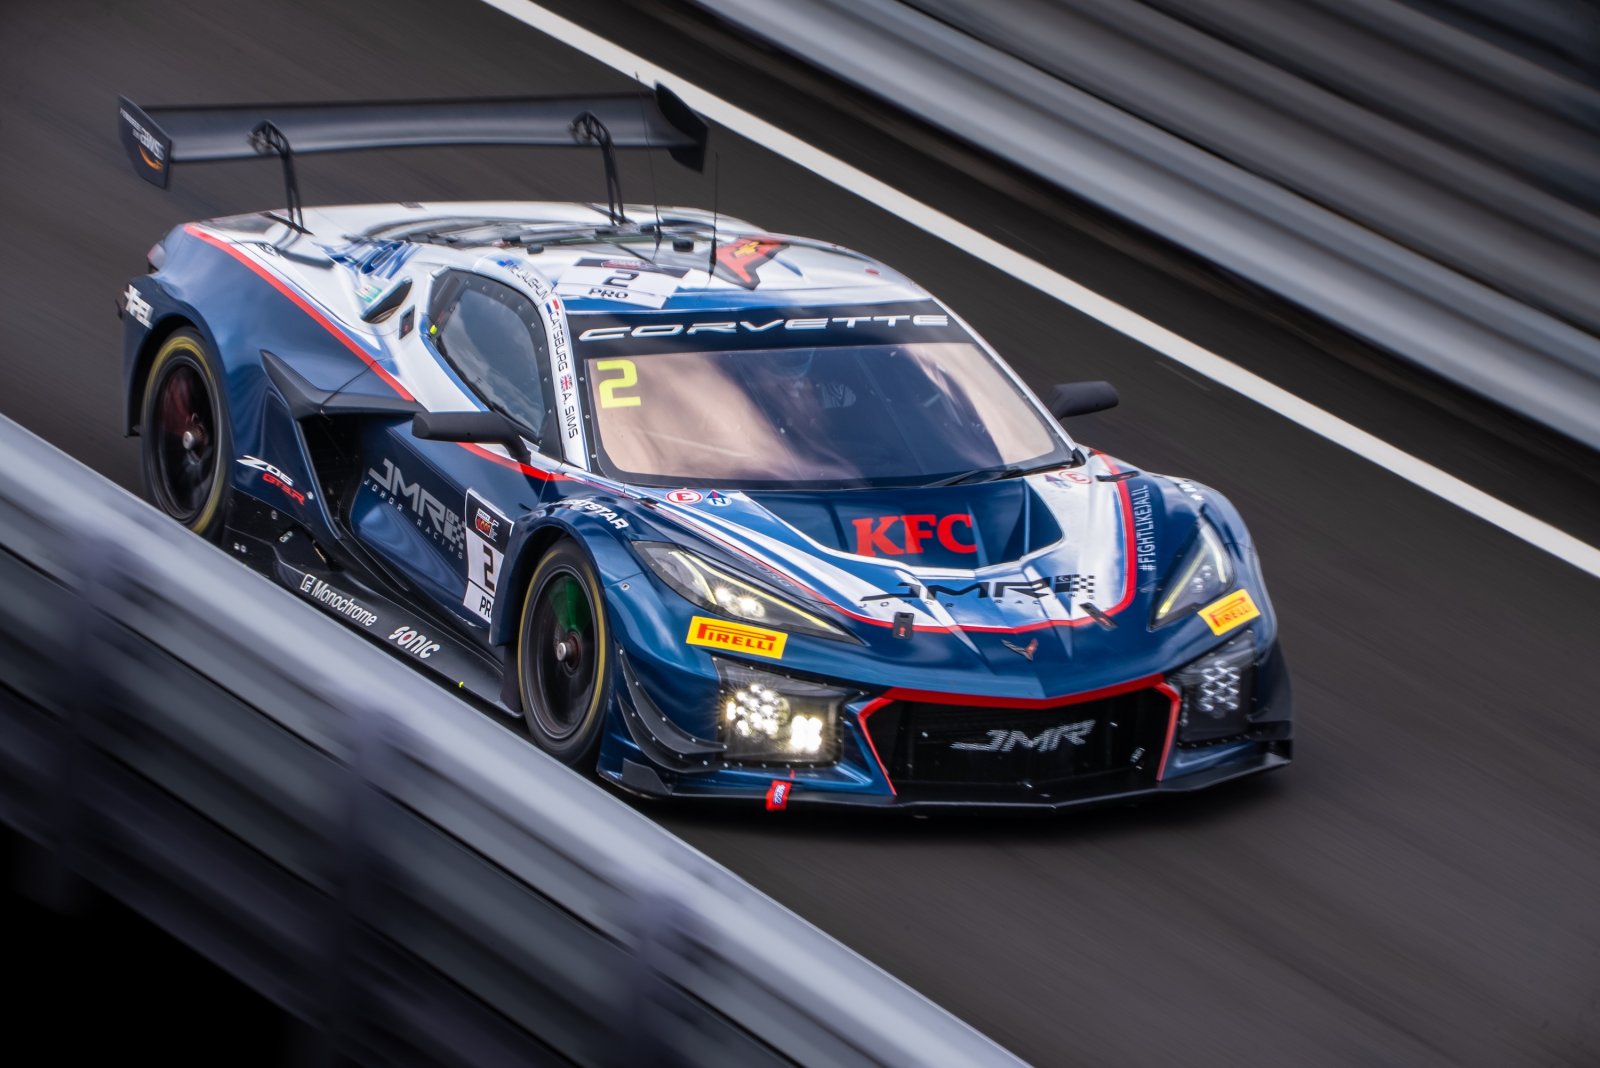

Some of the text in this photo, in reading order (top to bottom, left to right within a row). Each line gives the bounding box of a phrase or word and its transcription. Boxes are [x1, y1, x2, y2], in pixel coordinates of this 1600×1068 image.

[587, 287, 629, 299] PRO
[601, 269, 640, 288] 2
[578, 314, 949, 342] CORVETTE
[596, 359, 642, 409] 2
[564, 405, 579, 440] SIMS
[368, 457, 446, 535] JMR
[363, 479, 403, 512] JOHOR
[416, 518, 464, 560] RACING
[852, 513, 977, 557] KFC
[1131, 484, 1157, 572] #FIGHTLIKEJALIL
[483, 543, 497, 593] 2
[311, 580, 378, 627] Monochrome
[479, 594, 492, 618] PR
[860, 577, 1051, 601] JMR
[697, 623, 777, 651] PIRELLI
[950, 719, 1097, 752] JMR
